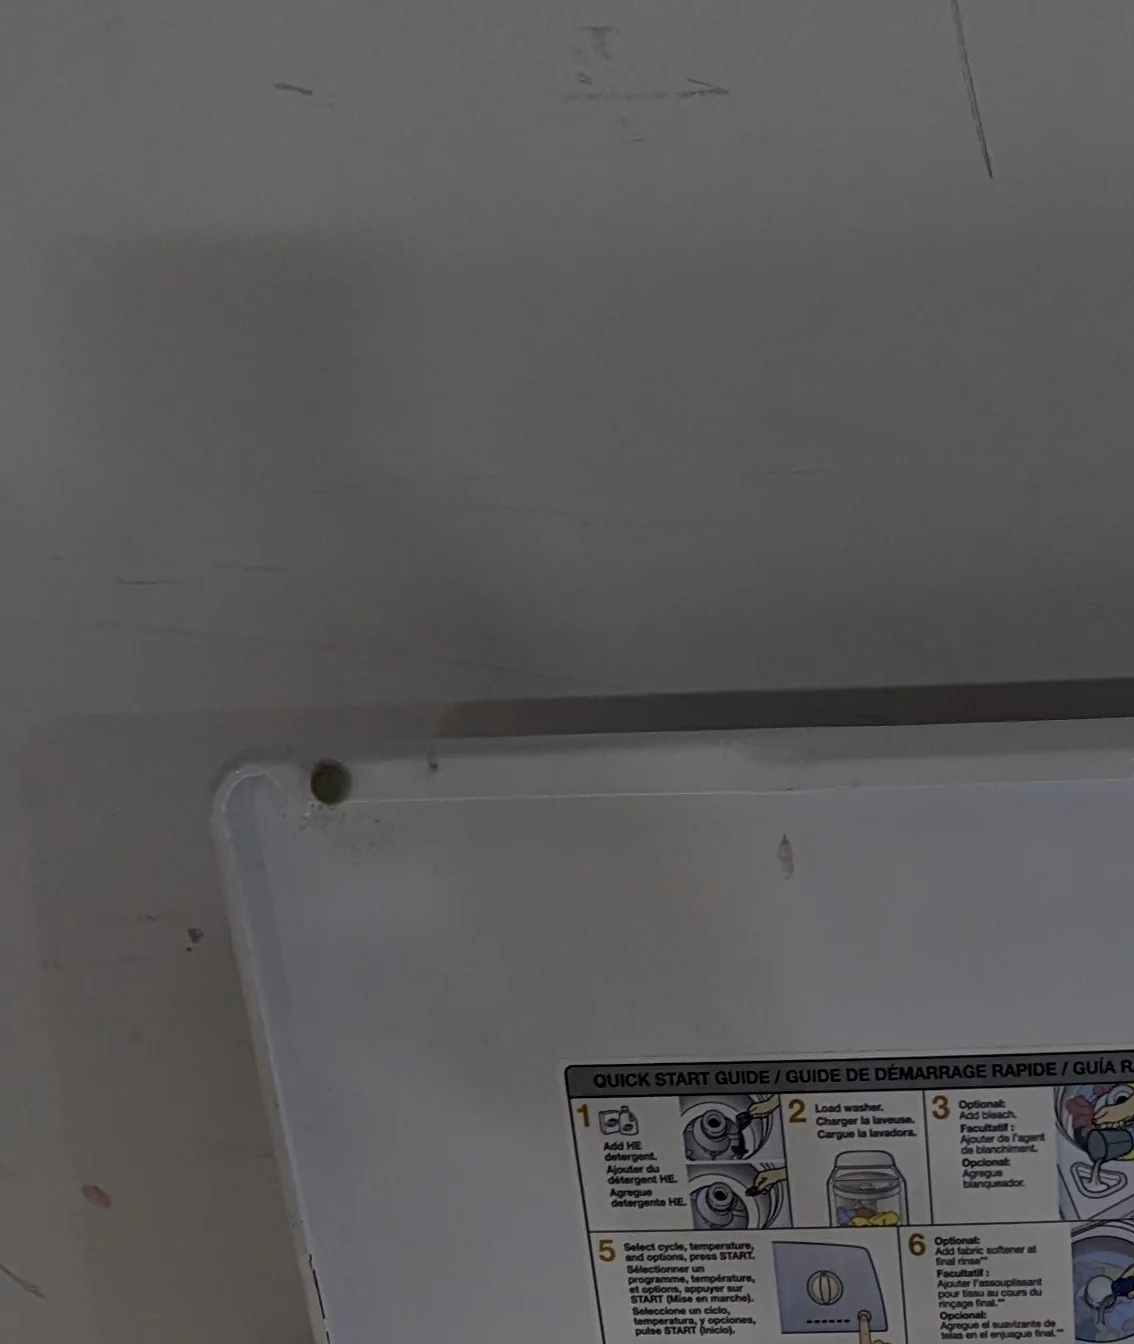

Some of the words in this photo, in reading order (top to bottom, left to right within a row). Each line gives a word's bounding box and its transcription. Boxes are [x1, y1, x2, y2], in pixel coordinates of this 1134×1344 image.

[592, 1072, 650, 1088] QUICK
[654, 1070, 710, 1086] START
[714, 1069, 770, 1085] GUIDE
[785, 1068, 840, 1083] GUIDE
[845, 1067, 869, 1081] DE
[874, 1063, 986, 1081] DÉMARRAGE
[991, 1062, 1056, 1077] RAPIDE
[1073, 1060, 1114, 1075] GUÍA
[787, 1098, 806, 1123] 2
[814, 1103, 842, 1113] Load
[843, 1103, 883, 1112] washer.
[931, 1095, 950, 1119] 3
[576, 1103, 591, 1127] 1
[815, 1116, 858, 1127] Charger
[859, 1116, 870, 1125] la
[871, 1115, 915, 1124] laveuse.
[816, 1129, 855, 1140] Cargue
[856, 1129, 867, 1137] la
[868, 1127, 917, 1137] lavadora.
[603, 1141, 625, 1150] Add
[625, 1141, 642, 1150] HE
[603, 1152, 657, 1163] detergent.
[605, 1164, 644, 1175] Ajouter
[645, 1164, 660, 1173] du
[606, 1175, 658, 1186] détergent
[658, 1174, 677, 1183] HE.
[597, 1239, 617, 1262] 5
[907, 1233, 926, 1256] 6
